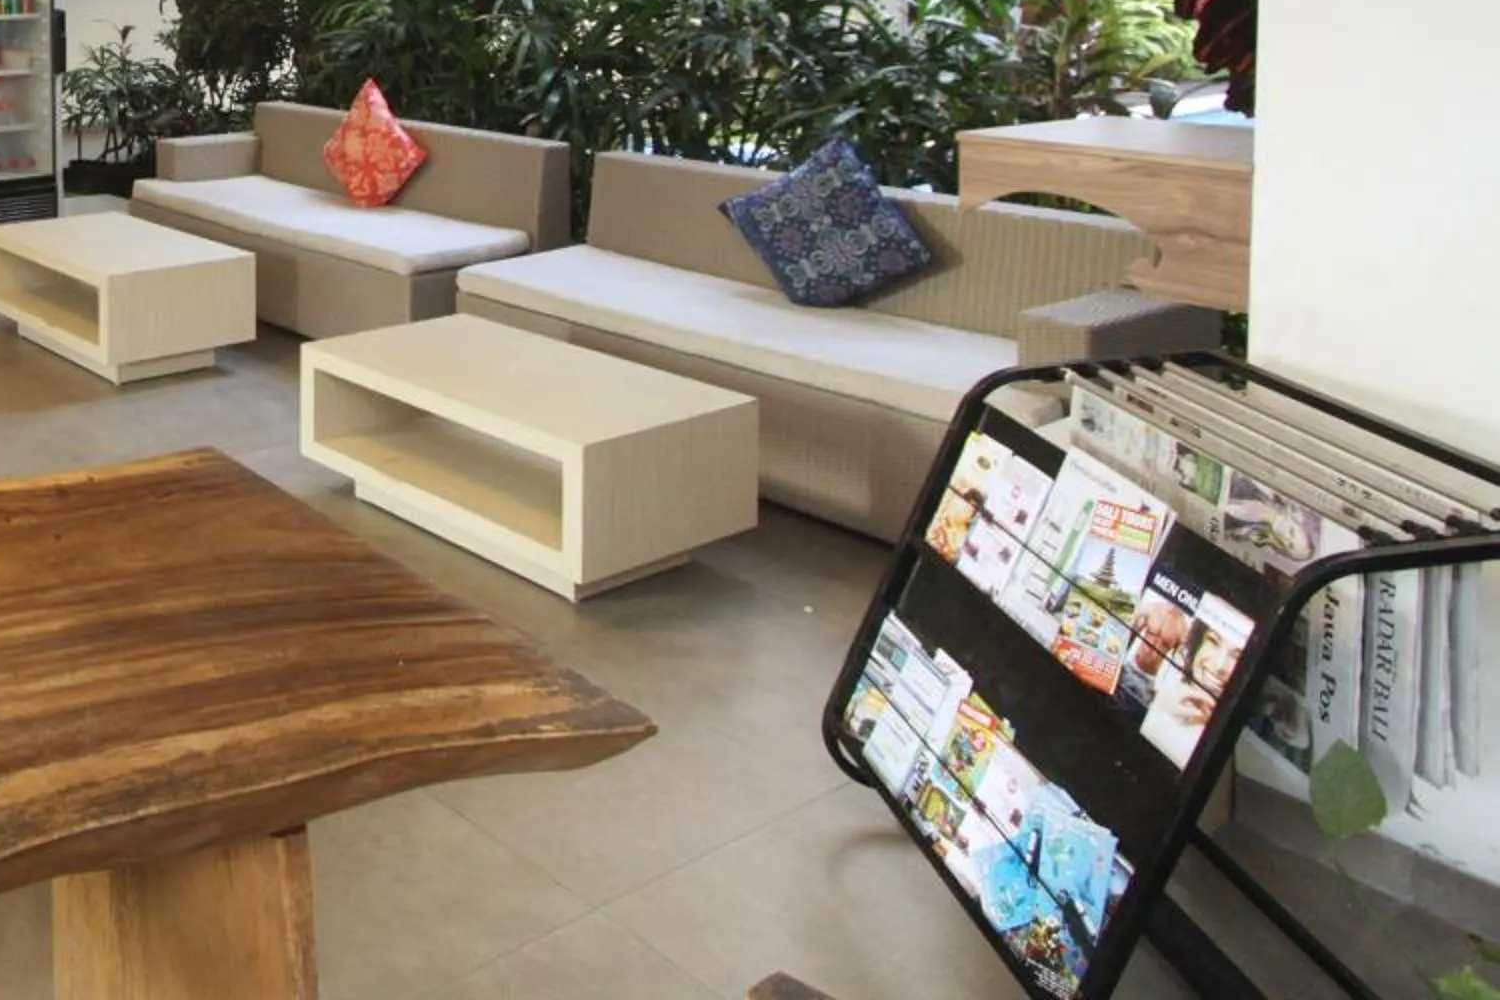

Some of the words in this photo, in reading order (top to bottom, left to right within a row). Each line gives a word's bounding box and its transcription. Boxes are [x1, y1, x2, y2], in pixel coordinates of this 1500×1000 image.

[1153, 572, 1180, 597] MEN
[1321, 585, 1341, 662] Jawa
[1375, 578, 1397, 675] RADAR
[1319, 671, 1338, 724] Pos
[1371, 679, 1391, 742] BALI
